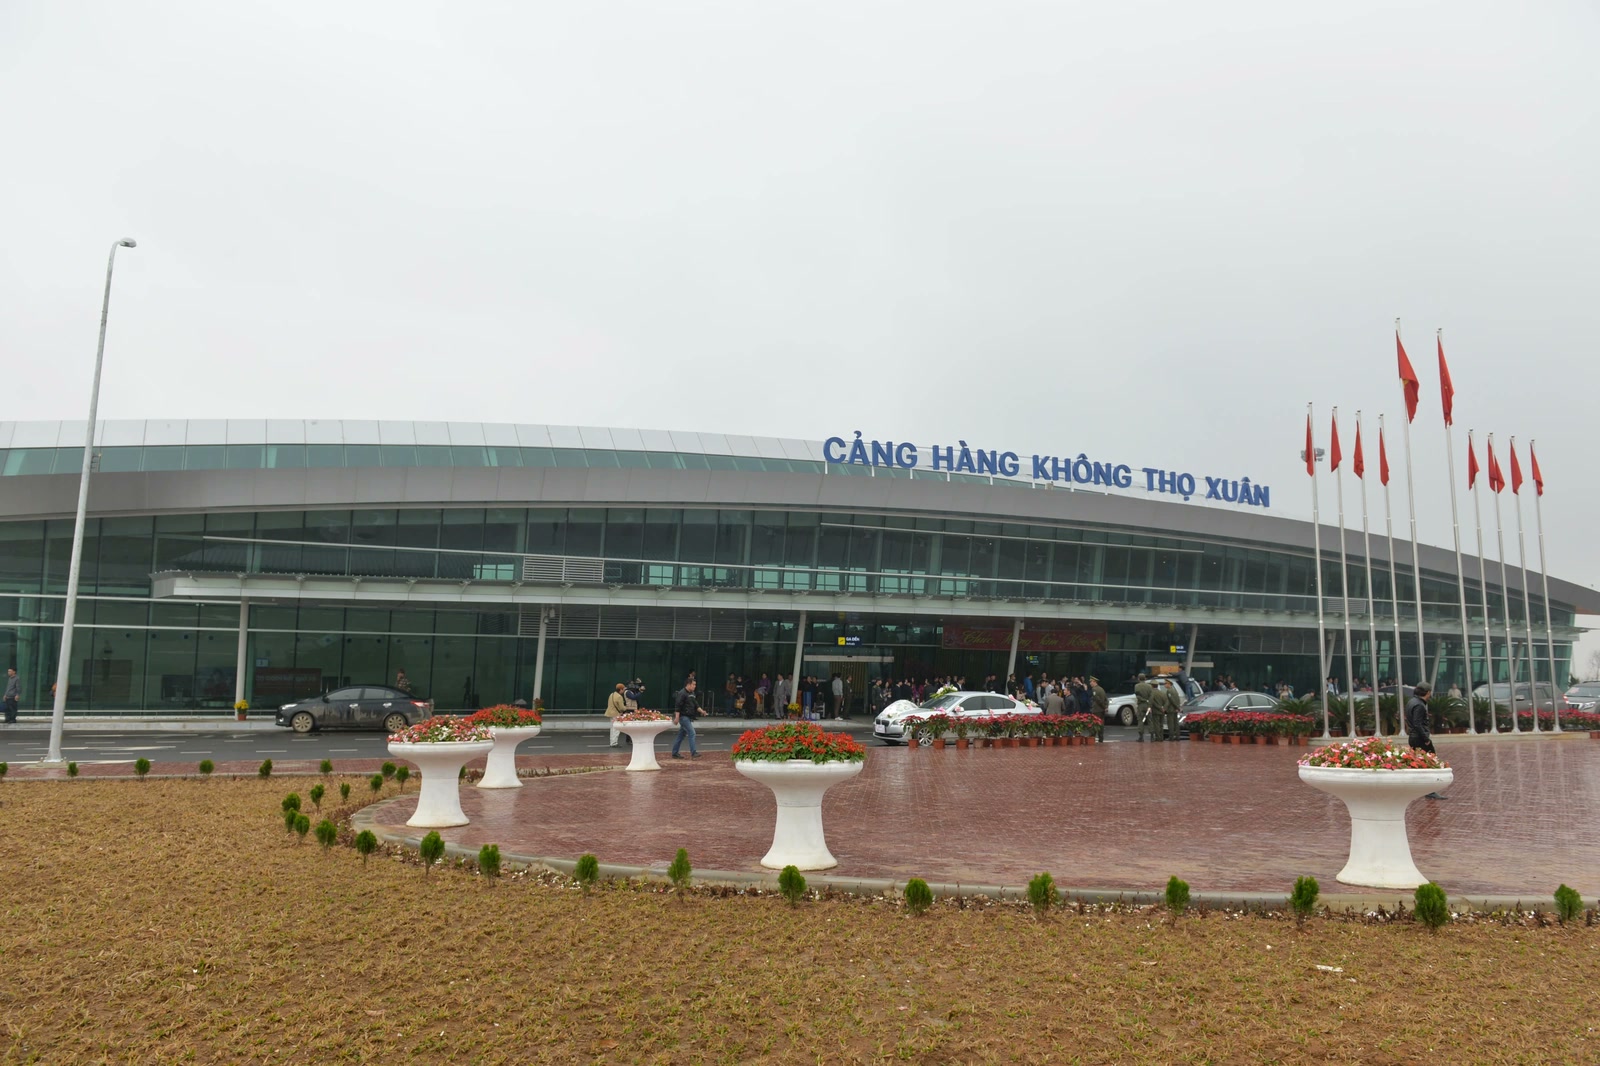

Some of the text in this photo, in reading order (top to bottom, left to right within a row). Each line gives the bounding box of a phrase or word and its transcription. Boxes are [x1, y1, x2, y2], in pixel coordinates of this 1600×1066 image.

[823, 430, 1270, 508] CẢNG HÀNG KHÔNG THỌ XUÂN
